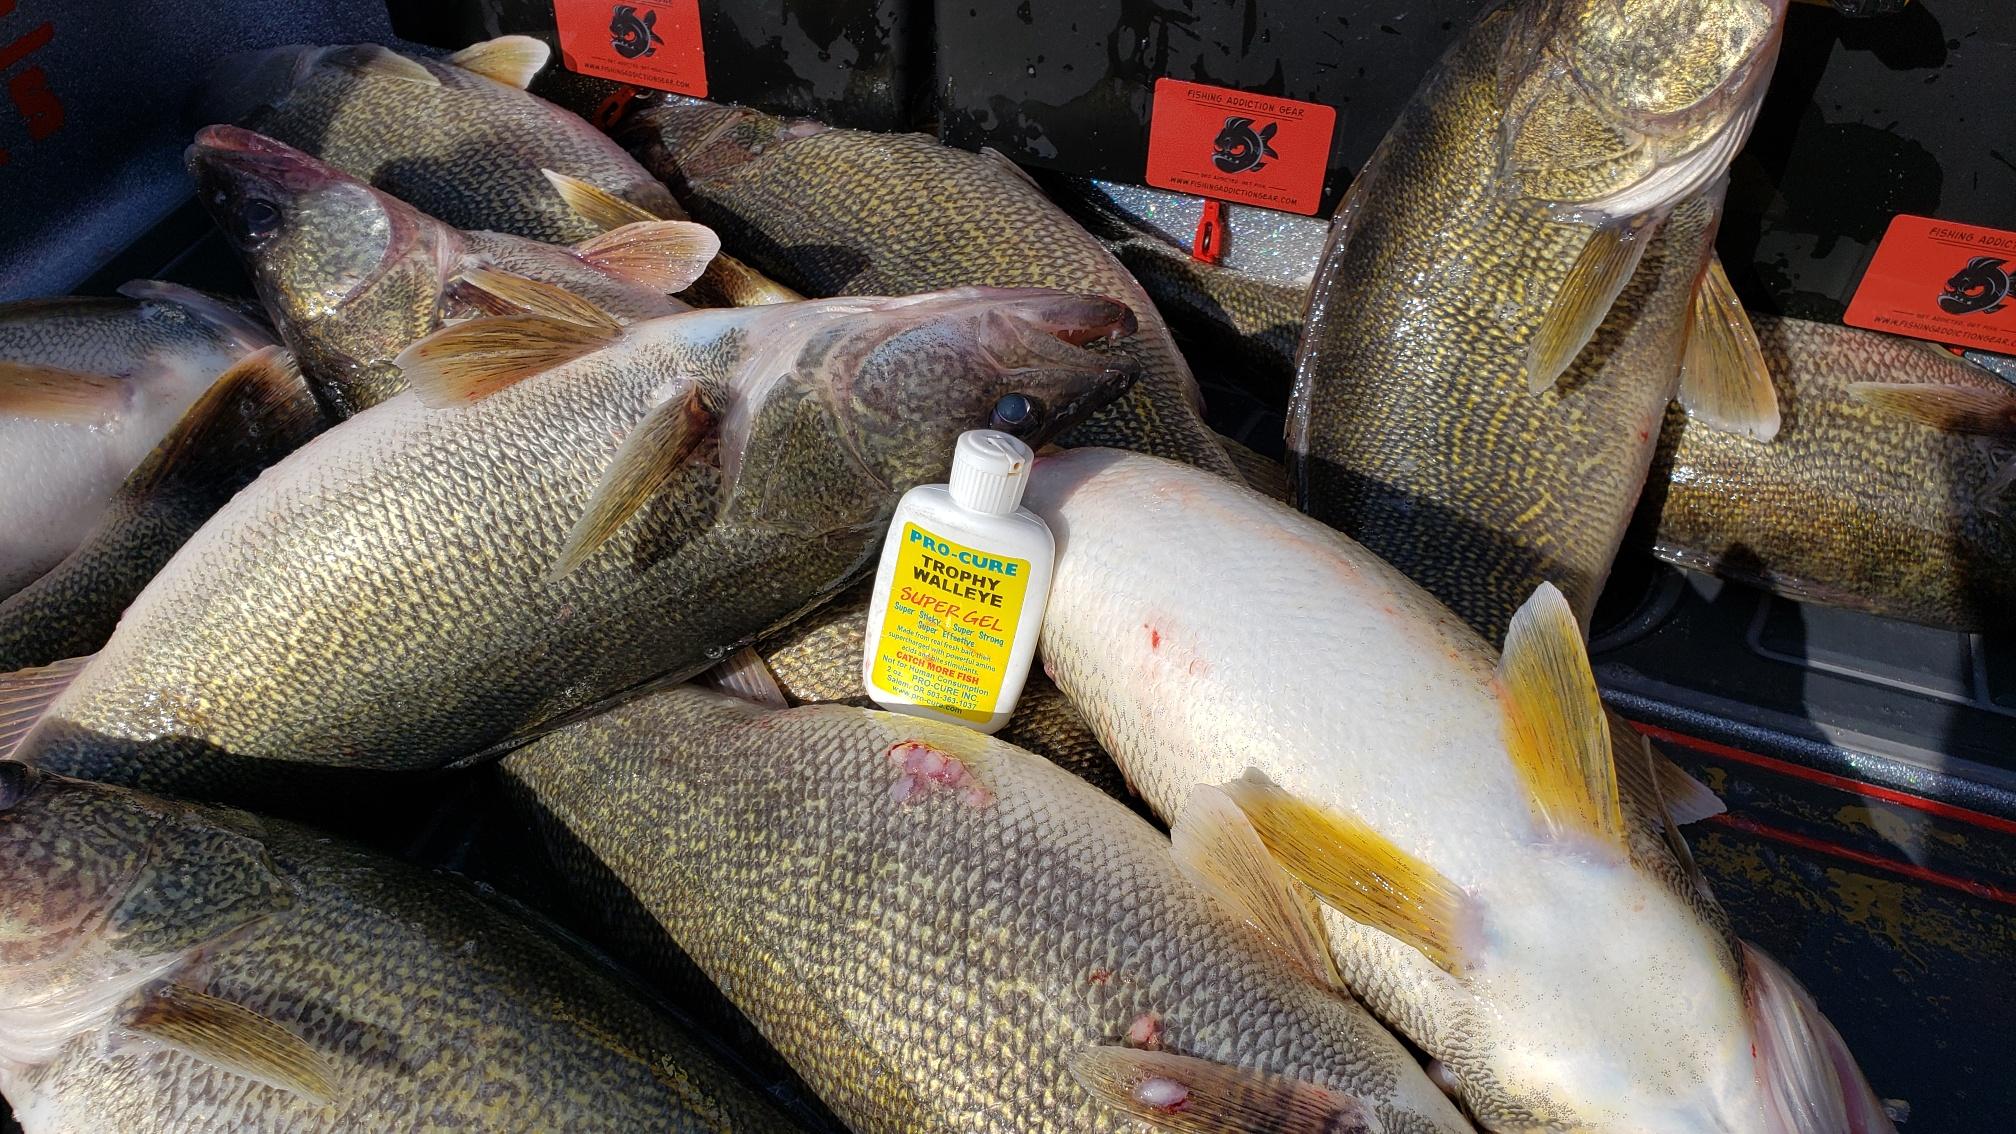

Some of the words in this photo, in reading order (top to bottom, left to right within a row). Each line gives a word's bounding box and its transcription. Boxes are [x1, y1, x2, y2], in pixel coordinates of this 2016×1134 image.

[1187, 89, 1222, 103] FISHING
[1226, 96, 1275, 112] ADDICTION
[1279, 105, 1305, 117] GEAR
[1929, 227, 1975, 242] FISHING
[910, 529, 1018, 577] PRO-CURE
[913, 566, 1003, 608] WALLEYE
[921, 554, 1000, 591] TROPHY
[894, 601, 915, 615] Super
[919, 610, 941, 626] Sticky
[952, 623, 975, 636] Super
[978, 631, 1004, 648] Strong
[900, 586, 960, 618] SUPER
[962, 610, 1003, 632] GEL
[888, 631, 931, 651] supercharged
[931, 646, 945, 656] with
[945, 652, 975, 666] powerful
[975, 660, 996, 672] amino
[896, 625, 915, 636] Made
[915, 630, 930, 642] from
[930, 638, 943, 647] real
[943, 641, 960, 652] fresh
[976, 652, 991, 663] then
[917, 620, 938, 634] Super
[942, 630, 975, 648] Effective
[896, 651, 925, 667] CATCH
[926, 661, 955, 678] MORE
[956, 671, 980, 686] FISH
[901, 644, 917, 655] acids
[918, 651, 931, 660] and
[931, 654, 944, 664] bite
[883, 654, 896, 665] Not
[896, 660, 907, 669] for
[908, 664, 935, 680] Human
[937, 675, 989, 697] Consumption
[911, 674, 959, 697] PRO-CURE
[961, 690, 979, 703] INC.
[892, 684, 963, 714] www.pro-cure.com
[913, 684, 925, 695] OR
[926, 689, 977, 710] 503-363-1037
